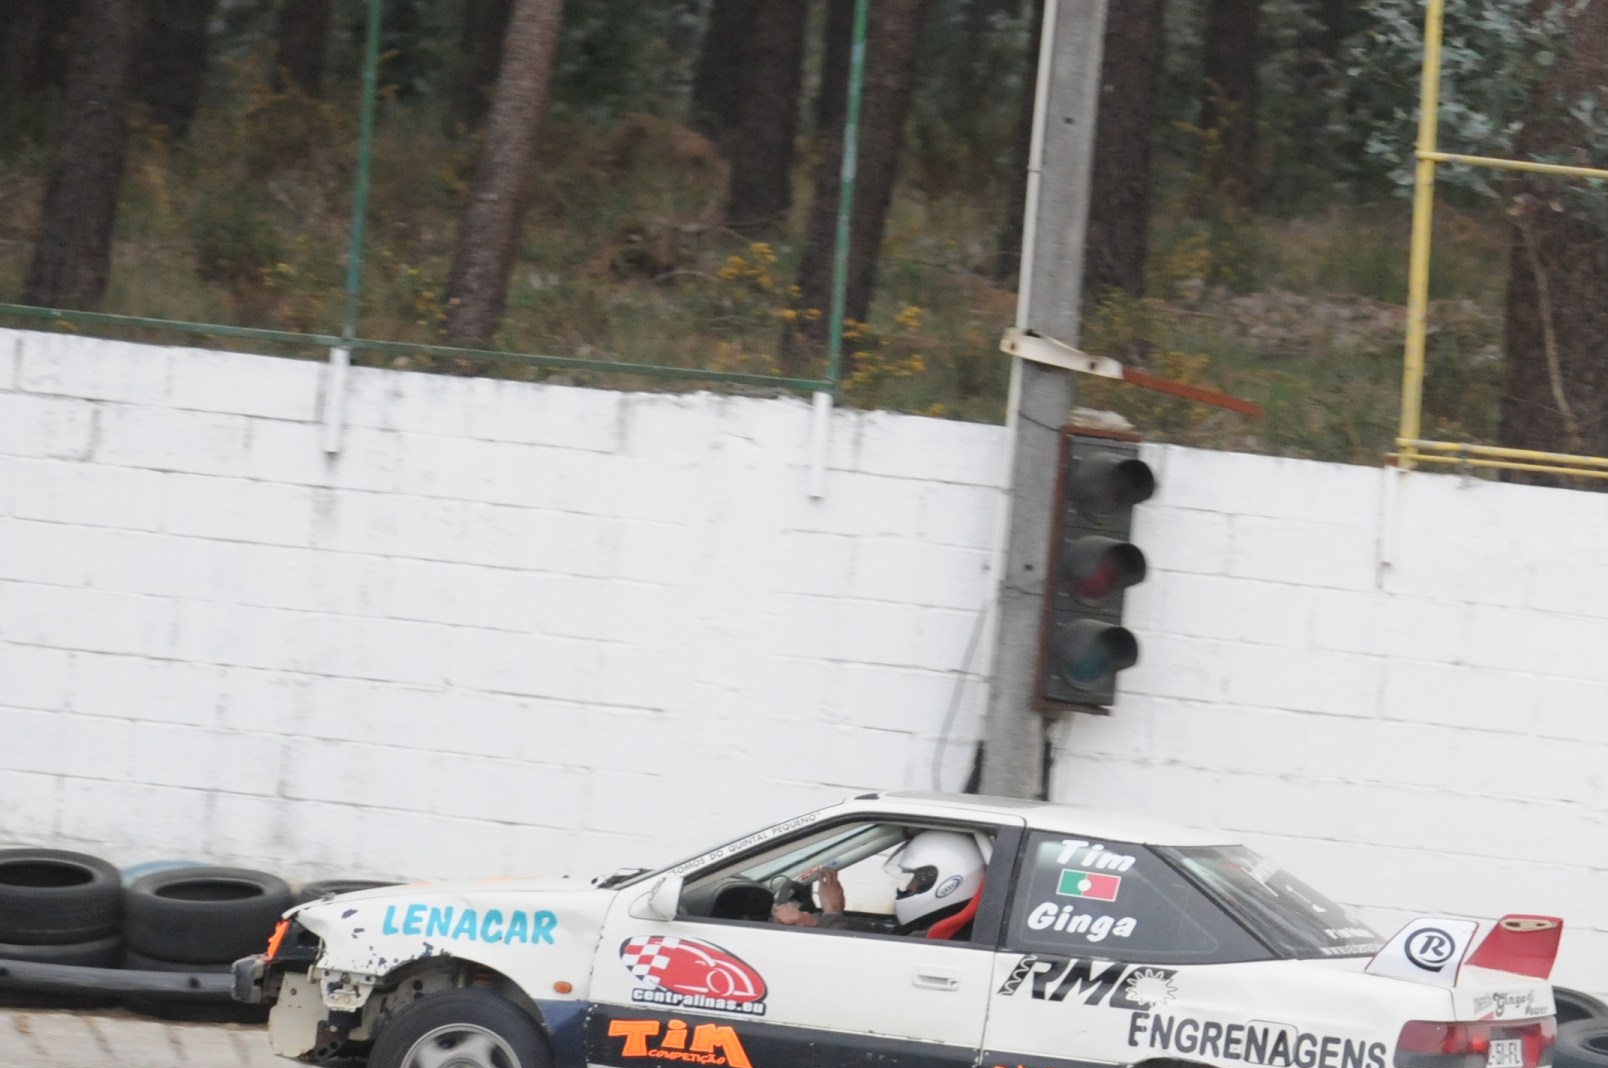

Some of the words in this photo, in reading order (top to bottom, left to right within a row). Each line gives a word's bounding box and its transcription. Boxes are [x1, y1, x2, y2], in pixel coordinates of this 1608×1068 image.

[1056, 839, 1137, 872] Tim
[382, 903, 558, 946] LENACAR
[1027, 902, 1138, 943] Ginga
[632, 989, 766, 1015] centralinas.eu
